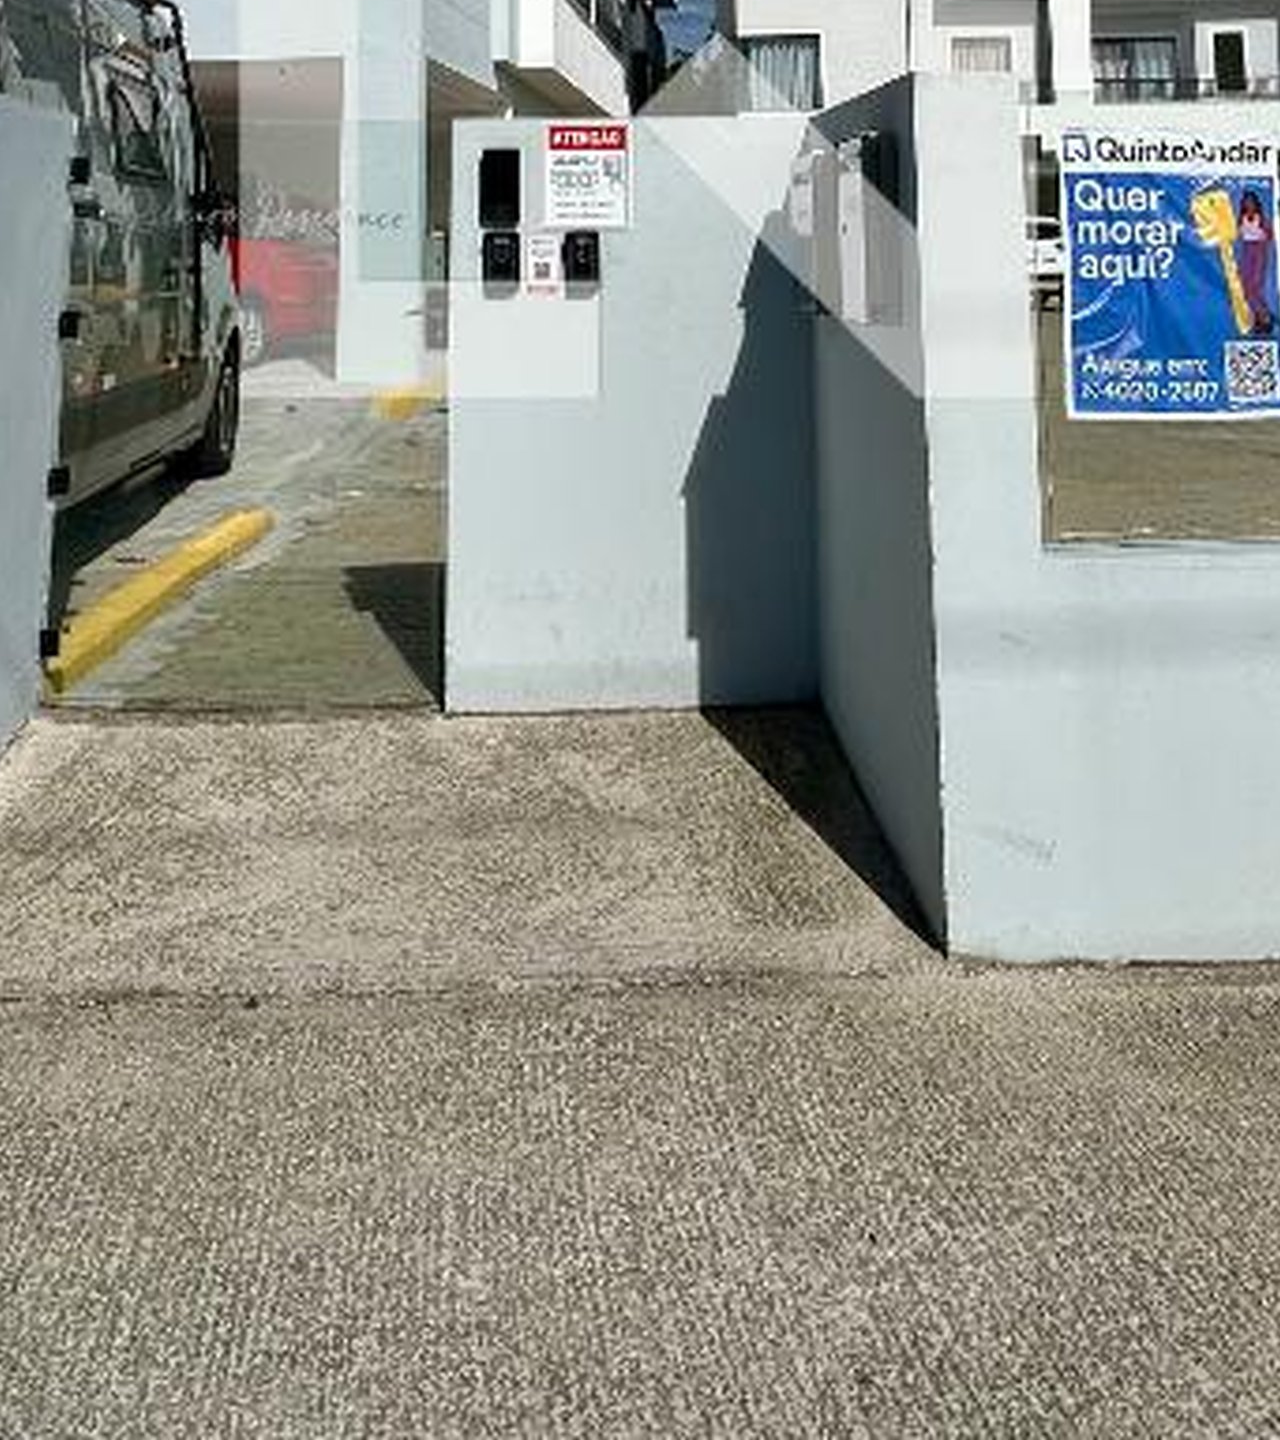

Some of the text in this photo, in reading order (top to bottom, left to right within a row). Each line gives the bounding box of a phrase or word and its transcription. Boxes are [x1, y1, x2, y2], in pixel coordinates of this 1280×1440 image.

[1094, 136, 1272, 162] QuintoAndar
[1074, 179, 1165, 211] Quer
[1077, 220, 1184, 245] morar
[1079, 248, 1175, 285] aqui?
